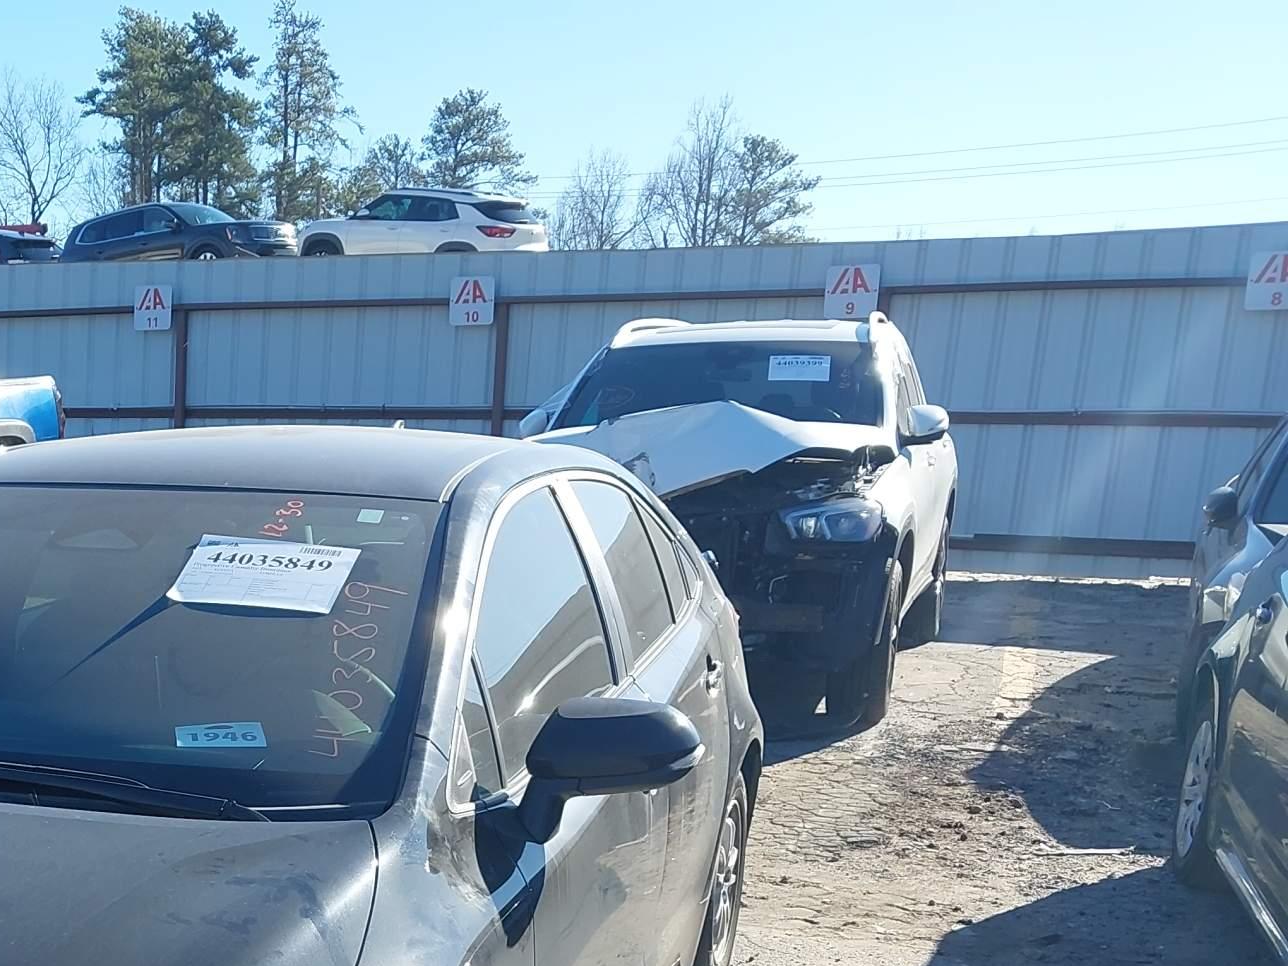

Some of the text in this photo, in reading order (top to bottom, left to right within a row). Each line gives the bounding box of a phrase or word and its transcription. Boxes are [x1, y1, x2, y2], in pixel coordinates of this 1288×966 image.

[1272, 292, 1282, 305] 8
[846, 302, 855, 314] 9
[147, 317, 158, 328] 11
[464, 311, 479, 323] 10
[207, 551, 333, 573] 44035849
[304, 582, 408, 757] 44035849
[185, 731, 257, 742] 1946
